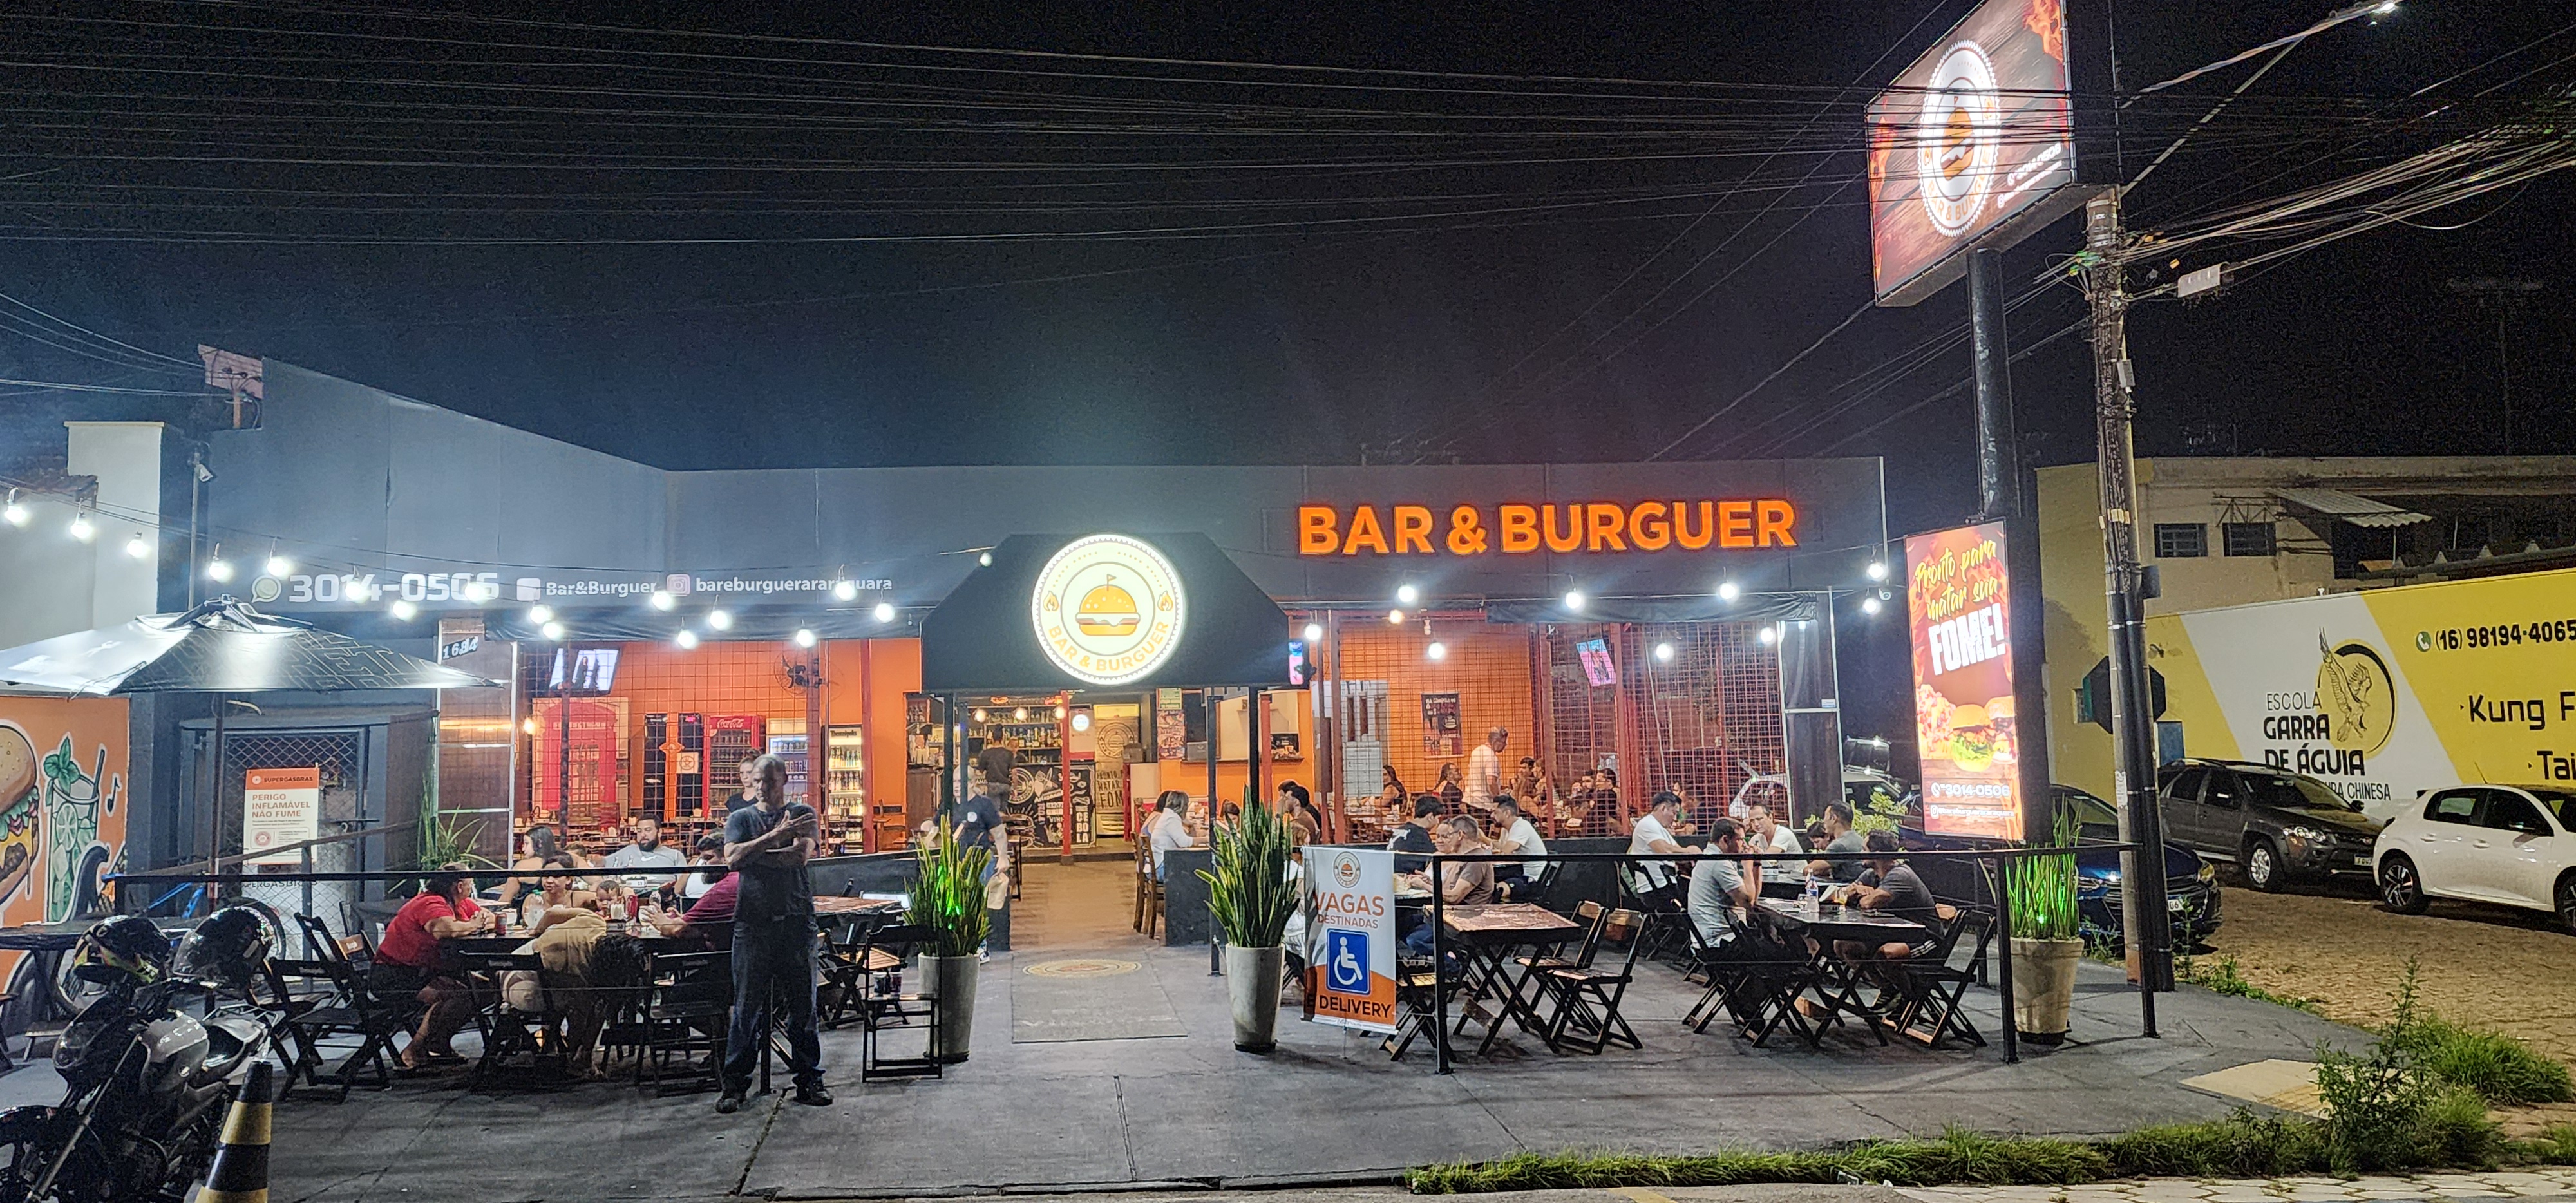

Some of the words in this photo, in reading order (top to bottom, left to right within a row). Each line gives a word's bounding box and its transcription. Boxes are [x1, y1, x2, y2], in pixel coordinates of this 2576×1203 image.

[1299, 505, 1435, 554] BAR
[1446, 504, 1487, 554] &
[1499, 499, 1798, 553] BURGUER
[1915, 547, 1956, 593] Pronto
[1960, 540, 1996, 582] para
[545, 580, 657, 596] Bar&Burguer
[1926, 582, 1967, 622] matar
[1973, 576, 1998, 602] sua
[1048, 625, 1078, 660] BAR
[1079, 655, 1090, 668] &
[1096, 621, 1169, 672] BURGUER
[1928, 603, 2006, 676] FOME!
[2436, 629, 2463, 650] (16)
[2266, 691, 2322, 710] ESCOLA
[2469, 694, 2546, 730] Kung
[2264, 714, 2331, 740] GARRA
[2264, 749, 2289, 770] DE
[2297, 743, 2365, 776] ÁGUIA
[2537, 750, 2576, 780] Tai
[1100, 790, 1124, 809] FOM
[2347, 782, 2391, 801] CHINESA
[252, 800, 310, 810] INFLAMÁVEL
[252, 810, 272, 818] NÃO
[1312, 891, 1385, 917] VAGAS
[1318, 914, 1379, 929] DESTINADAS
[1319, 994, 1392, 1018] DELIVERY
